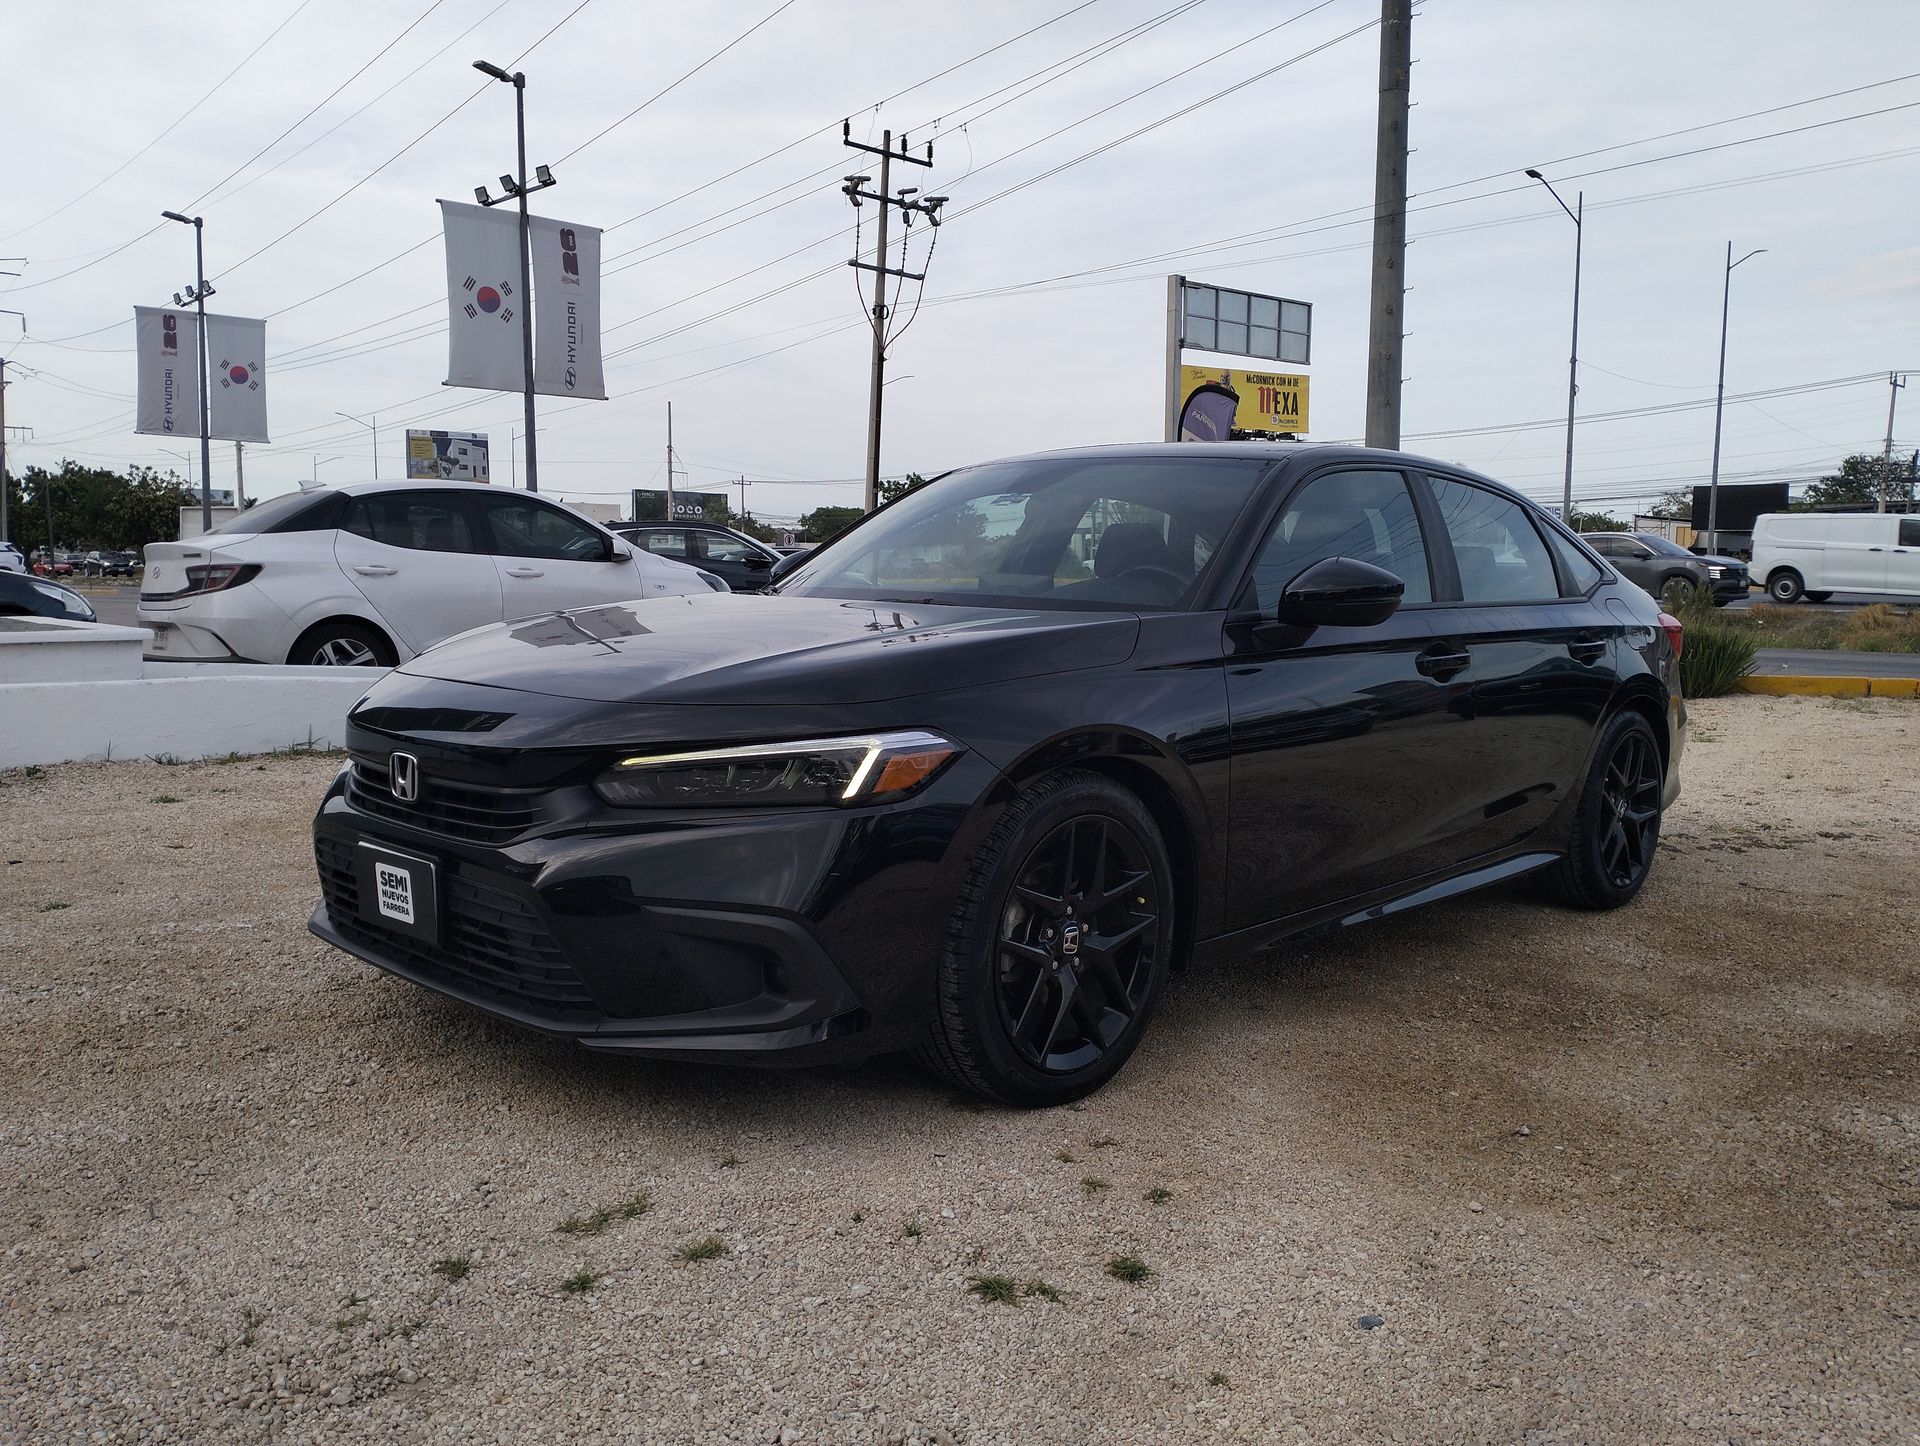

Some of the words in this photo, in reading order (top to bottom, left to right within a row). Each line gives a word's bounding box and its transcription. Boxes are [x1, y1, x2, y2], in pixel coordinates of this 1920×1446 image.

[567, 301, 576, 363] HYUNDAI
[165, 368, 173, 414] HYUNDAI
[1276, 376, 1286, 386] CON
[1287, 377, 1292, 387] M
[1292, 377, 1299, 388] DE
[380, 870, 408, 893] SEMI
[381, 888, 409, 905] NUEVOS
[382, 900, 410, 916] FARRERA
